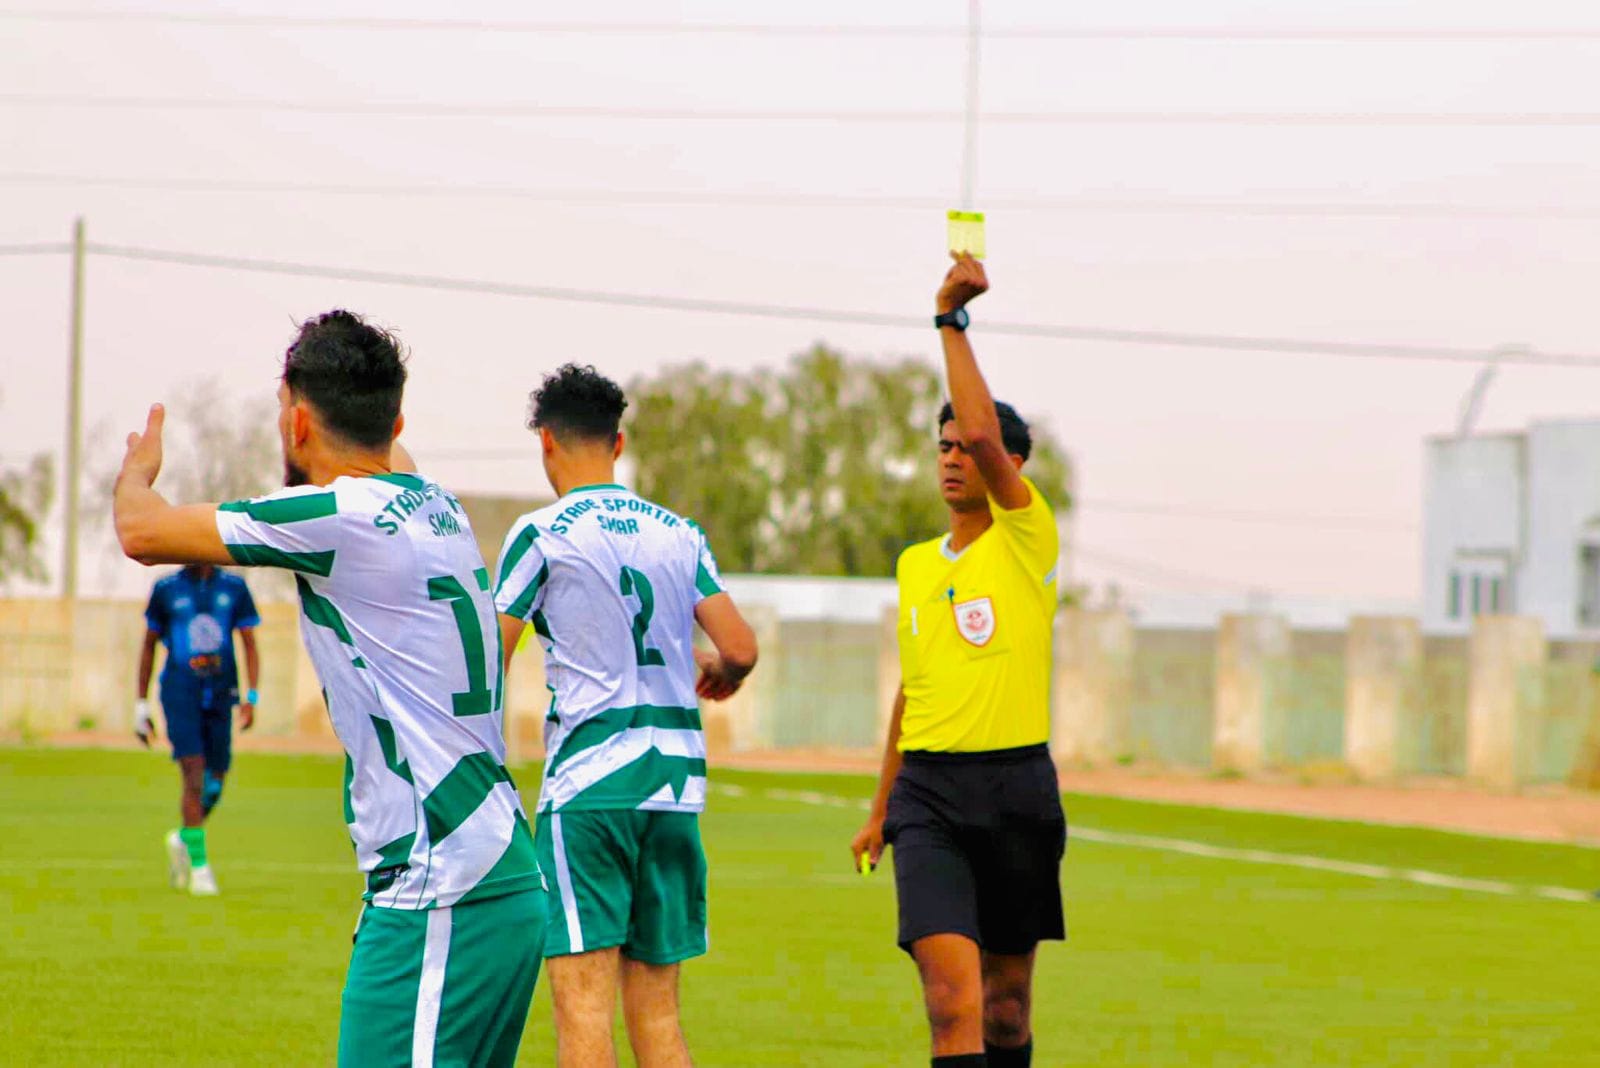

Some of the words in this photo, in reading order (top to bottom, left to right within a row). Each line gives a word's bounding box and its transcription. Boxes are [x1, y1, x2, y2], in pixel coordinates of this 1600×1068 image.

[550, 498, 600, 534] STADE
[596, 514, 640, 535] SMAR
[620, 565, 666, 666] 2
